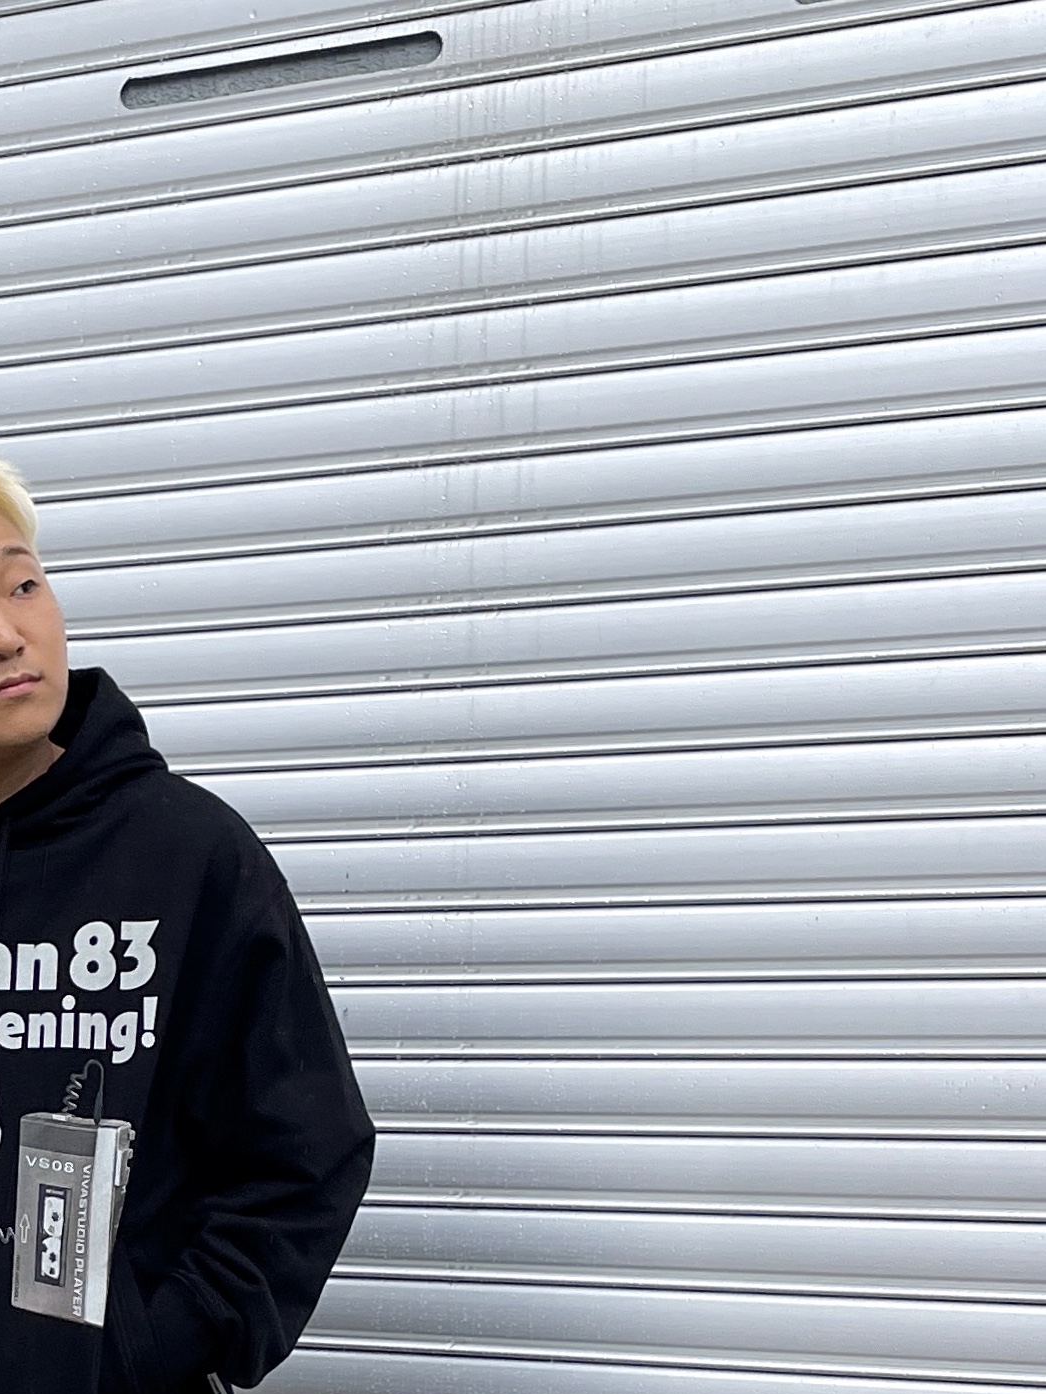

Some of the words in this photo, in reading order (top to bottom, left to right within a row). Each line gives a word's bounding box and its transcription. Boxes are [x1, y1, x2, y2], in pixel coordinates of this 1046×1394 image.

[69, 920, 159, 991] 83
[25, 1155, 75, 1173] VS08
[75, 1164, 92, 1254] VIVASTUDIO
[72, 1256, 85, 1317] PLAYER
